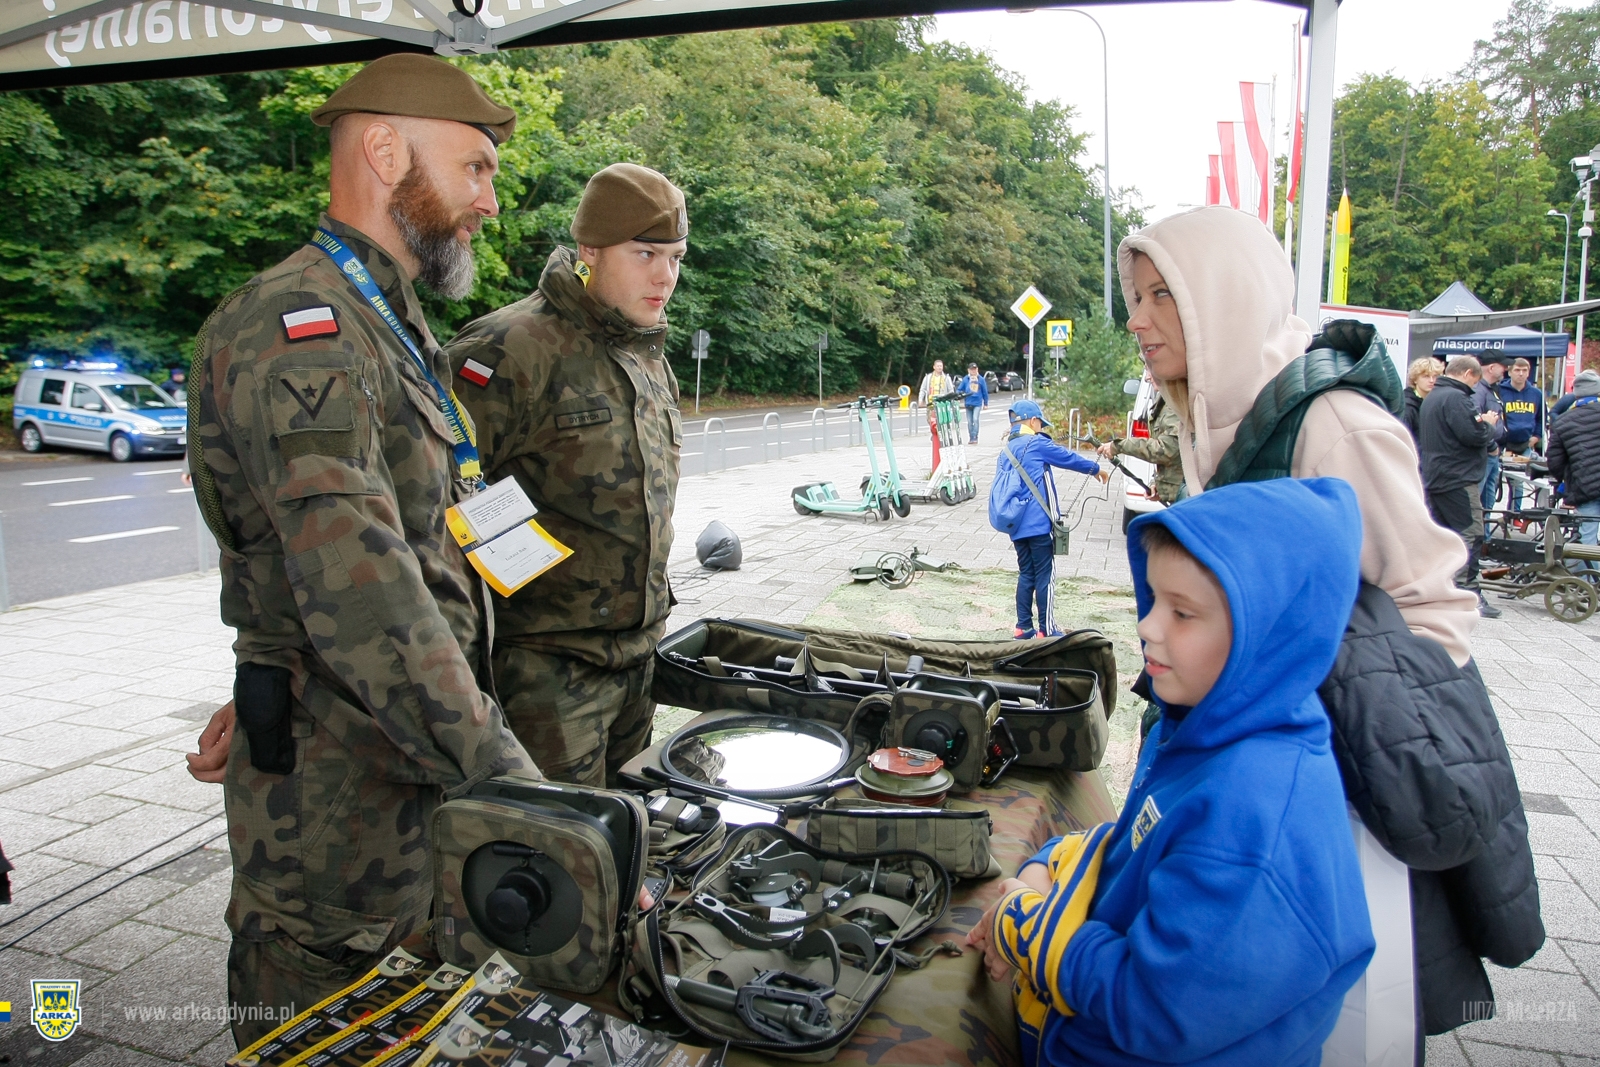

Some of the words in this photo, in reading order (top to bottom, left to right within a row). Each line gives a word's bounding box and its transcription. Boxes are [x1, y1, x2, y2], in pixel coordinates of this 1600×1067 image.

[370, 295, 390, 317] ARKA
[387, 316, 408, 342] GDYNIA
[1505, 401, 1535, 414] ARKA
[486, 545, 496, 555] 1
